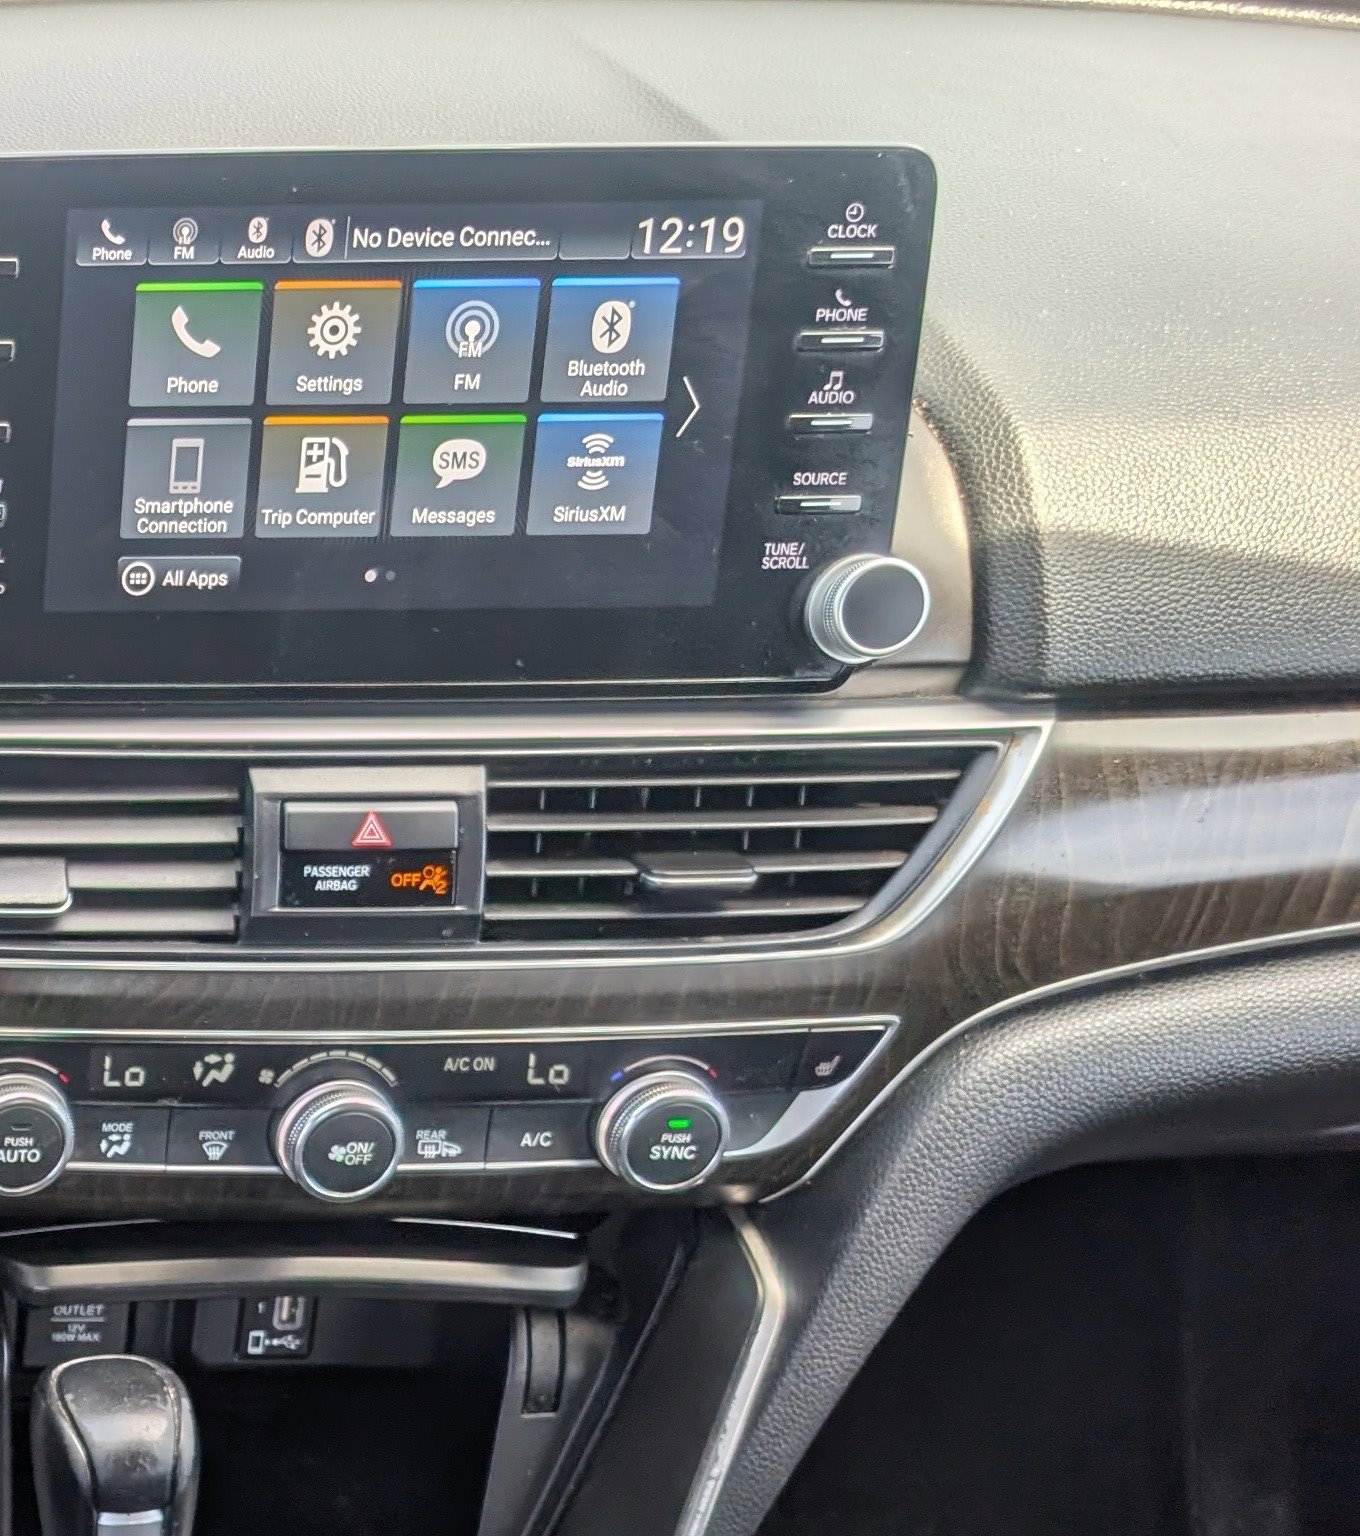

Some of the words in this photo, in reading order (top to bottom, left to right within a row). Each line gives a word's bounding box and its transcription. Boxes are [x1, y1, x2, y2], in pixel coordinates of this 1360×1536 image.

[352, 228, 381, 248] No
[387, 227, 455, 248] Device
[638, 216, 745, 255] 12:19
[827, 224, 878, 239] CLOCK
[92, 247, 132, 261] Phone
[173, 247, 195, 260] FM
[237, 246, 275, 259] Audio
[815, 308, 868, 322] PHONE
[567, 359, 645, 377] Bluetooth
[166, 377, 219, 393] Phone
[296, 375, 363, 395] Settings
[454, 374, 481, 390] FM
[580, 380, 628, 396] Audio
[807, 391, 855, 405] AUDIO
[438, 450, 480, 470] SMS
[792, 472, 848, 486] SOURCE
[134, 497, 233, 516] Smartphone
[553, 505, 627, 522] SiriusXM
[261, 508, 292, 528] Trip
[295, 508, 376, 528] Computer
[412, 507, 496, 528] Messages
[136, 517, 228, 534] Connection
[764, 541, 806, 556] TUNE/
[761, 556, 810, 570] SCROLL
[162, 570, 183, 587] All
[186, 570, 228, 590] Apps
[303, 864, 372, 878] PASSENGER
[314, 878, 359, 892] AIRBAG
[390, 873, 421, 888] OFF
[443, 1057, 471, 1072] A/C
[472, 1056, 495, 1072] ON
[101, 1121, 134, 1133] MODE
[416, 1129, 446, 1140] REAR
[3, 1136, 34, 1147] PUSH
[198, 1130, 236, 1141] FRONT
[519, 1131, 553, 1148] A/C
[660, 1132, 692, 1144] PUSH
[346, 1141, 376, 1154] ON/
[649, 1145, 698, 1161] SYNC
[344, 1153, 373, 1166] OFF
[52, 1303, 105, 1316] OUTLET
